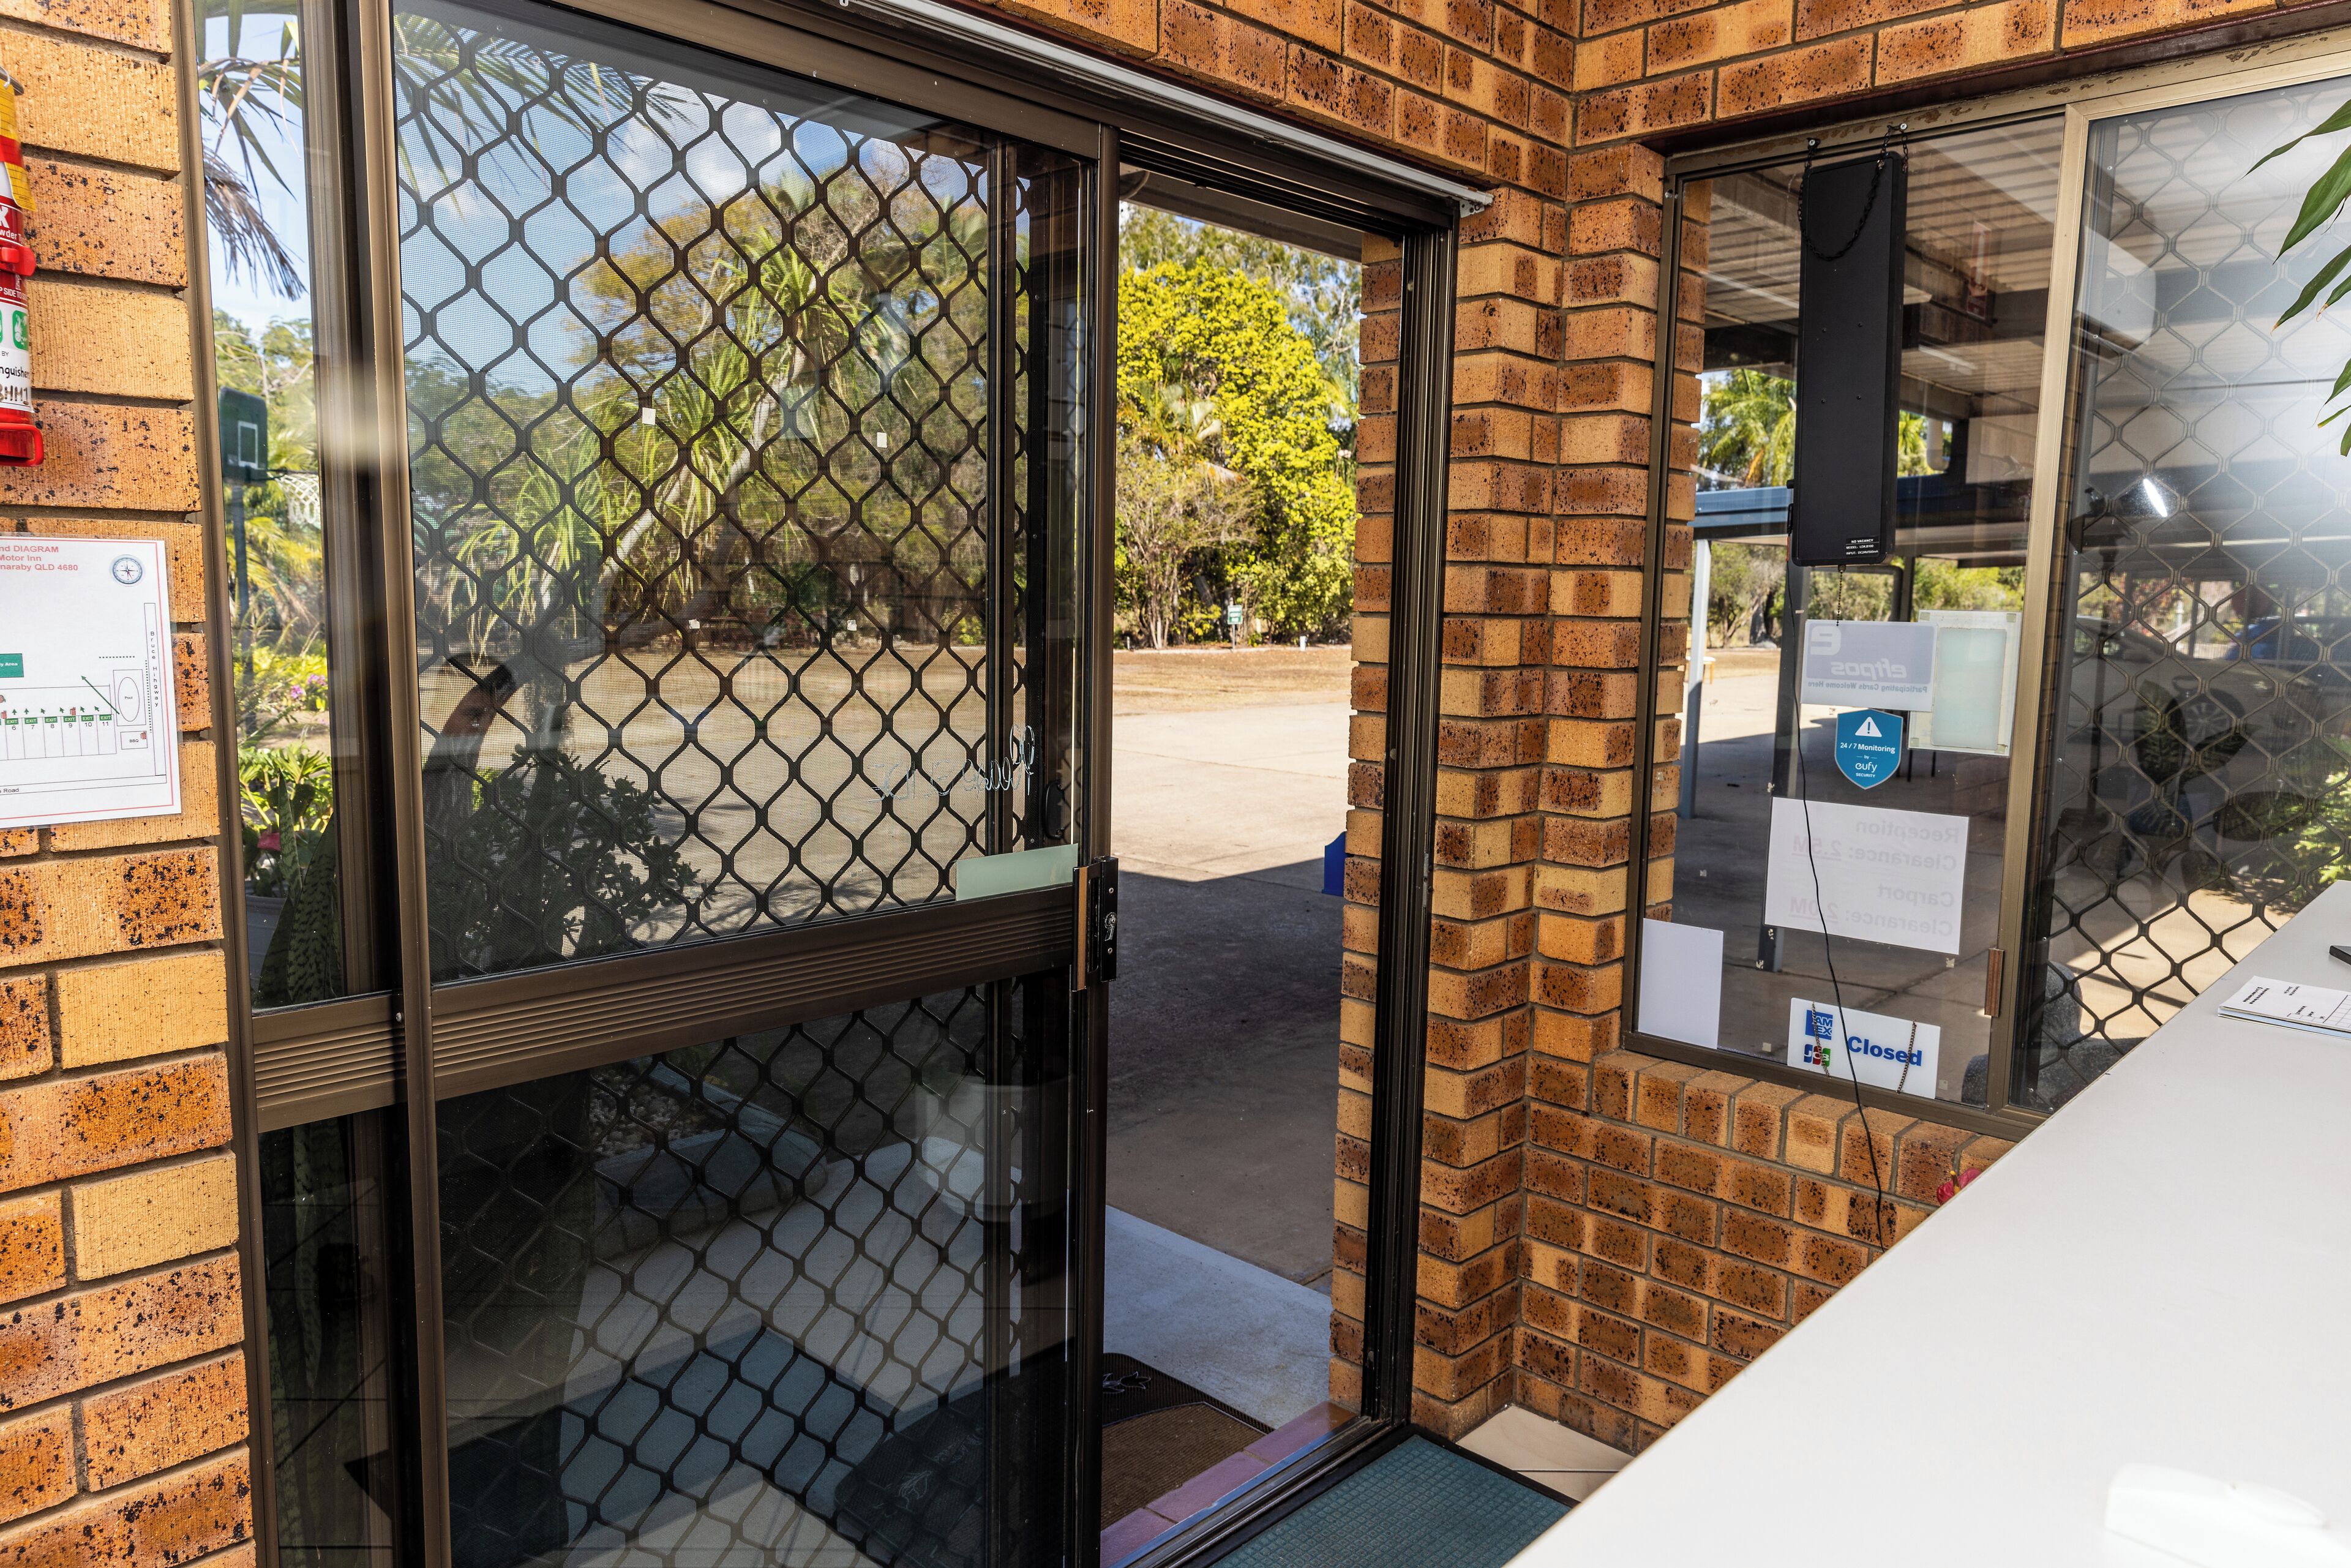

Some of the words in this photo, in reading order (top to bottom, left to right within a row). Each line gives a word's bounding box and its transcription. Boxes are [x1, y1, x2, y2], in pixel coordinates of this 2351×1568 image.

[1858, 743, 1895, 754] Monitoring
[1855, 762, 1877, 773] eufy
[1847, 1036, 1922, 1067] Closed
